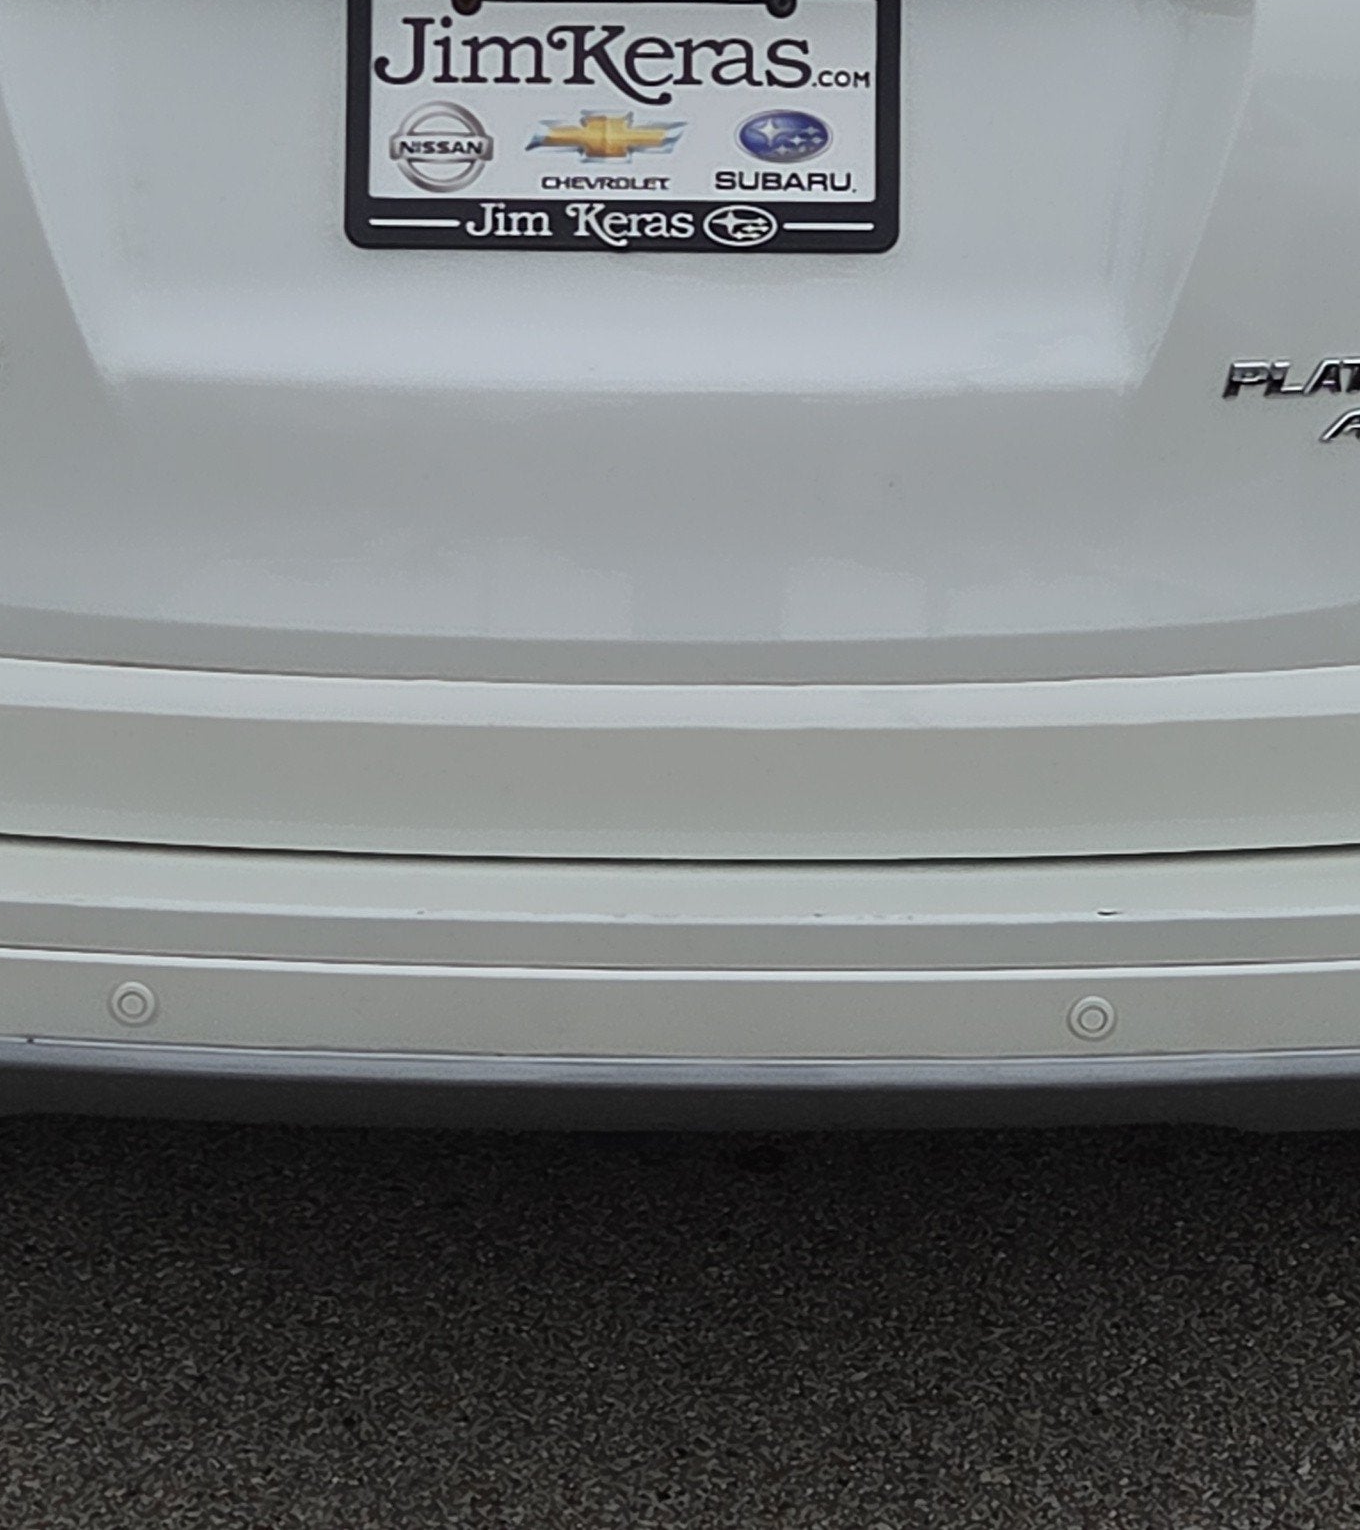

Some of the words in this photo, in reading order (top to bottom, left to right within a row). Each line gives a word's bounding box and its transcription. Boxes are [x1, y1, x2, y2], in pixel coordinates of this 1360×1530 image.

[400, 140, 482, 155] NISSAN
[541, 176, 671, 191] CHEVROLET
[465, 203, 554, 237] Jim
[565, 203, 696, 248] Keras
